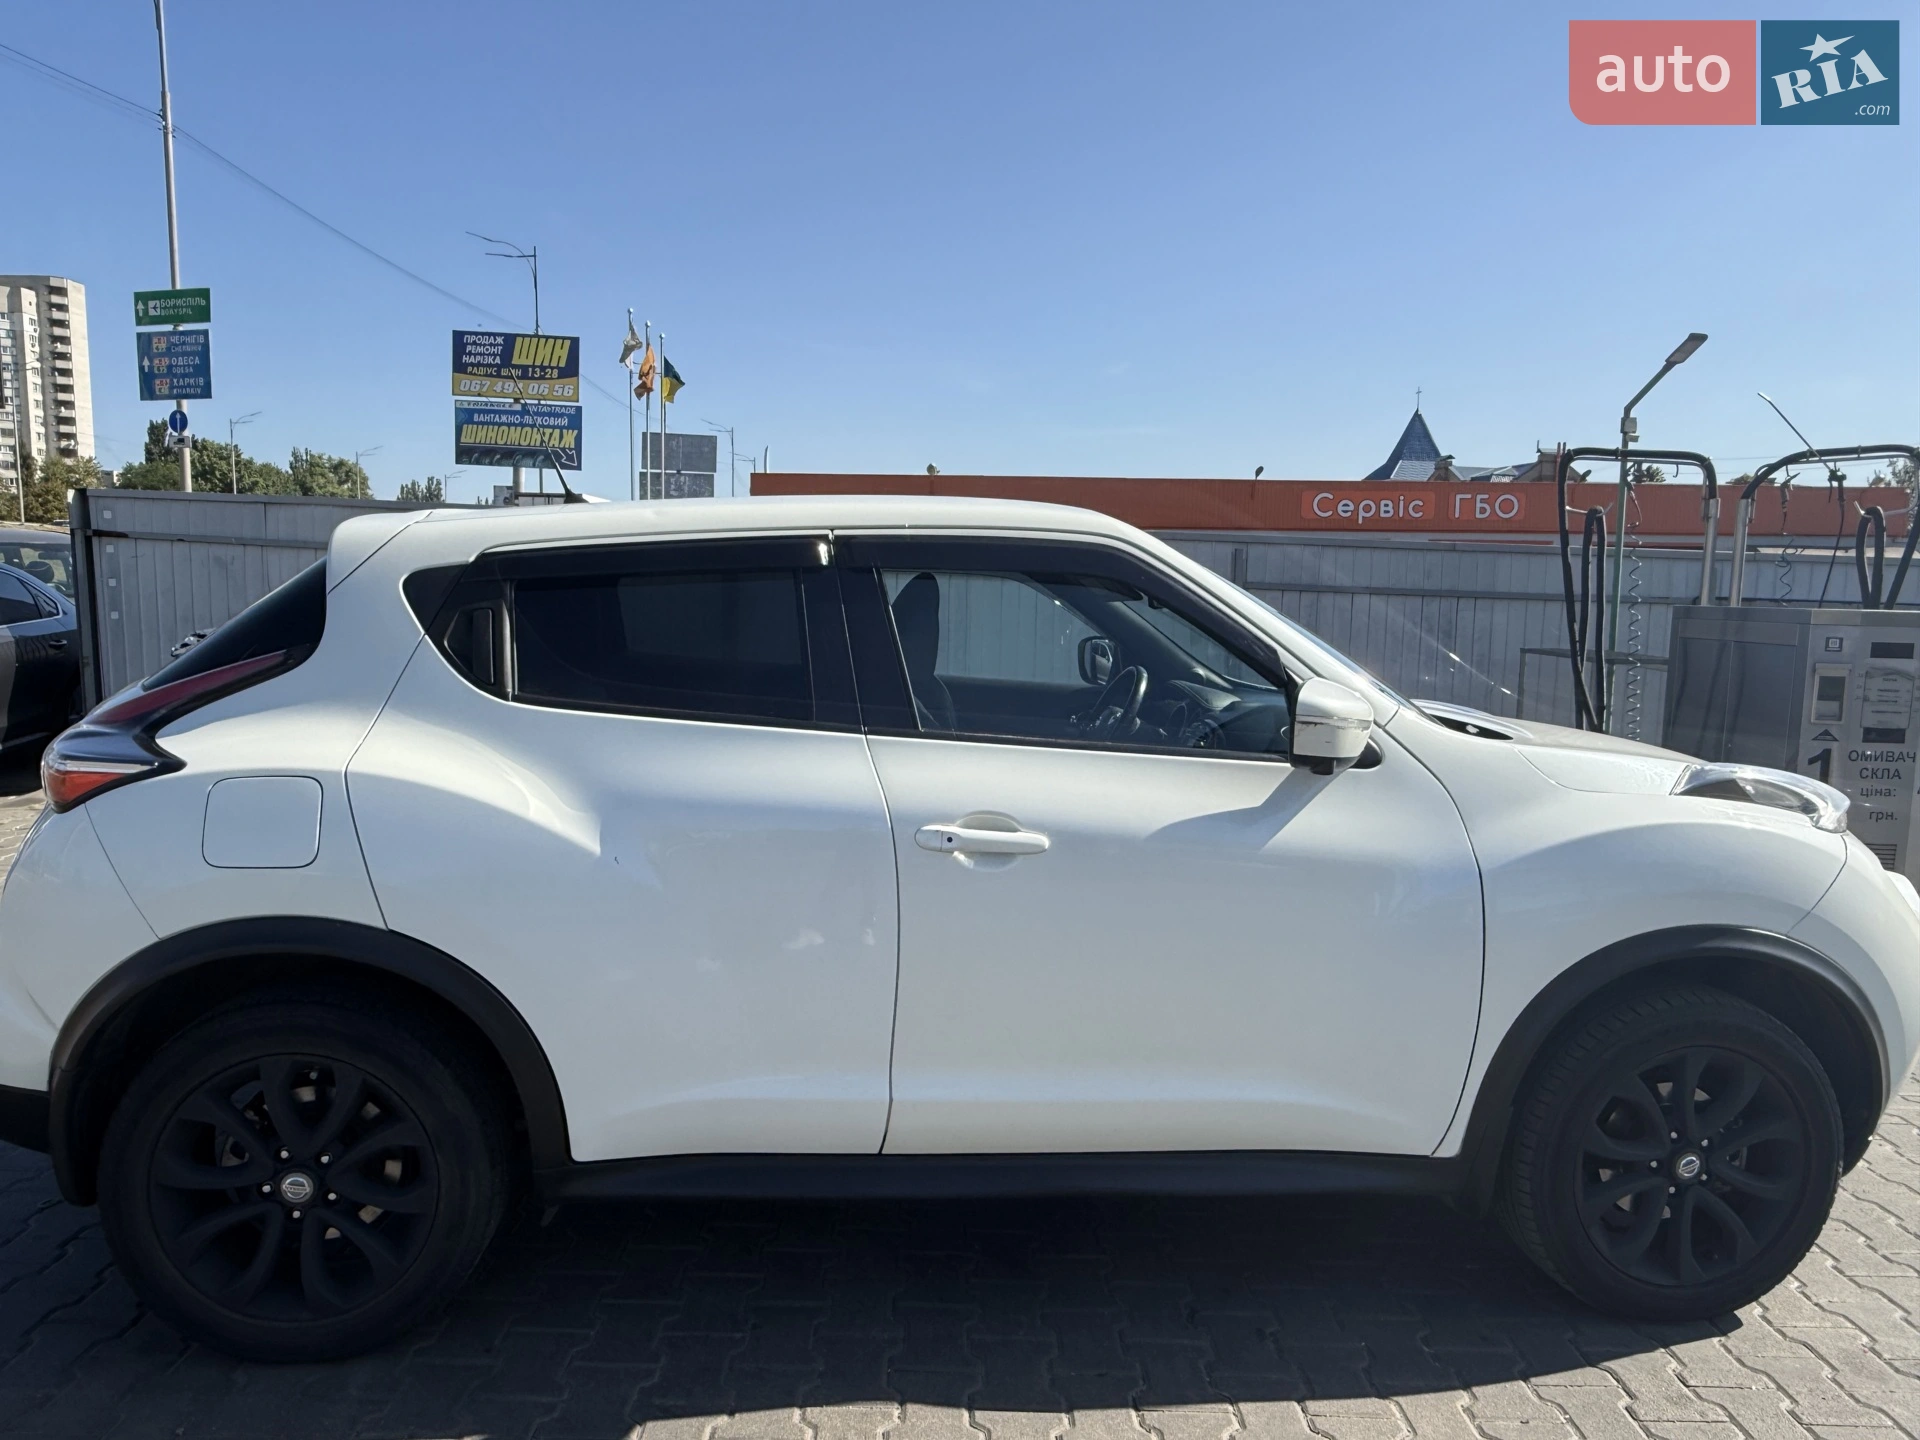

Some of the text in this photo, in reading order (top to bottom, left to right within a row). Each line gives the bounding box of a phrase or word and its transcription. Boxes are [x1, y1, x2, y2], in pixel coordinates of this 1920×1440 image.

[161, 298, 206, 308] БОРИСПІЛЬ
[170, 335, 205, 343] ЧЕРНІГІВ
[464, 335, 504, 345] ПРОДАЖ
[466, 345, 503, 354] РЕМОНТ
[511, 336, 571, 368] ШИН
[171, 356, 200, 366] ОДЕСА
[462, 355, 501, 364] НАРІЗКА
[467, 366, 497, 375] РАДІУС
[528, 367, 559, 379] 13-28
[173, 377, 205, 387] ХАРКІВ
[459, 379, 491, 393] 067
[527, 383, 551, 397] 06
[552, 384, 575, 397] 56
[460, 424, 578, 448] ШИНОМОНТАЖ
[1312, 492, 1519, 524] Сервіс ГБО
[1848, 749, 1916, 762] ОМИВАЧ
[1859, 767, 1901, 780] СКЛА
[1860, 784, 1897, 798] ціна:
[1869, 811, 1898, 823] грн.
